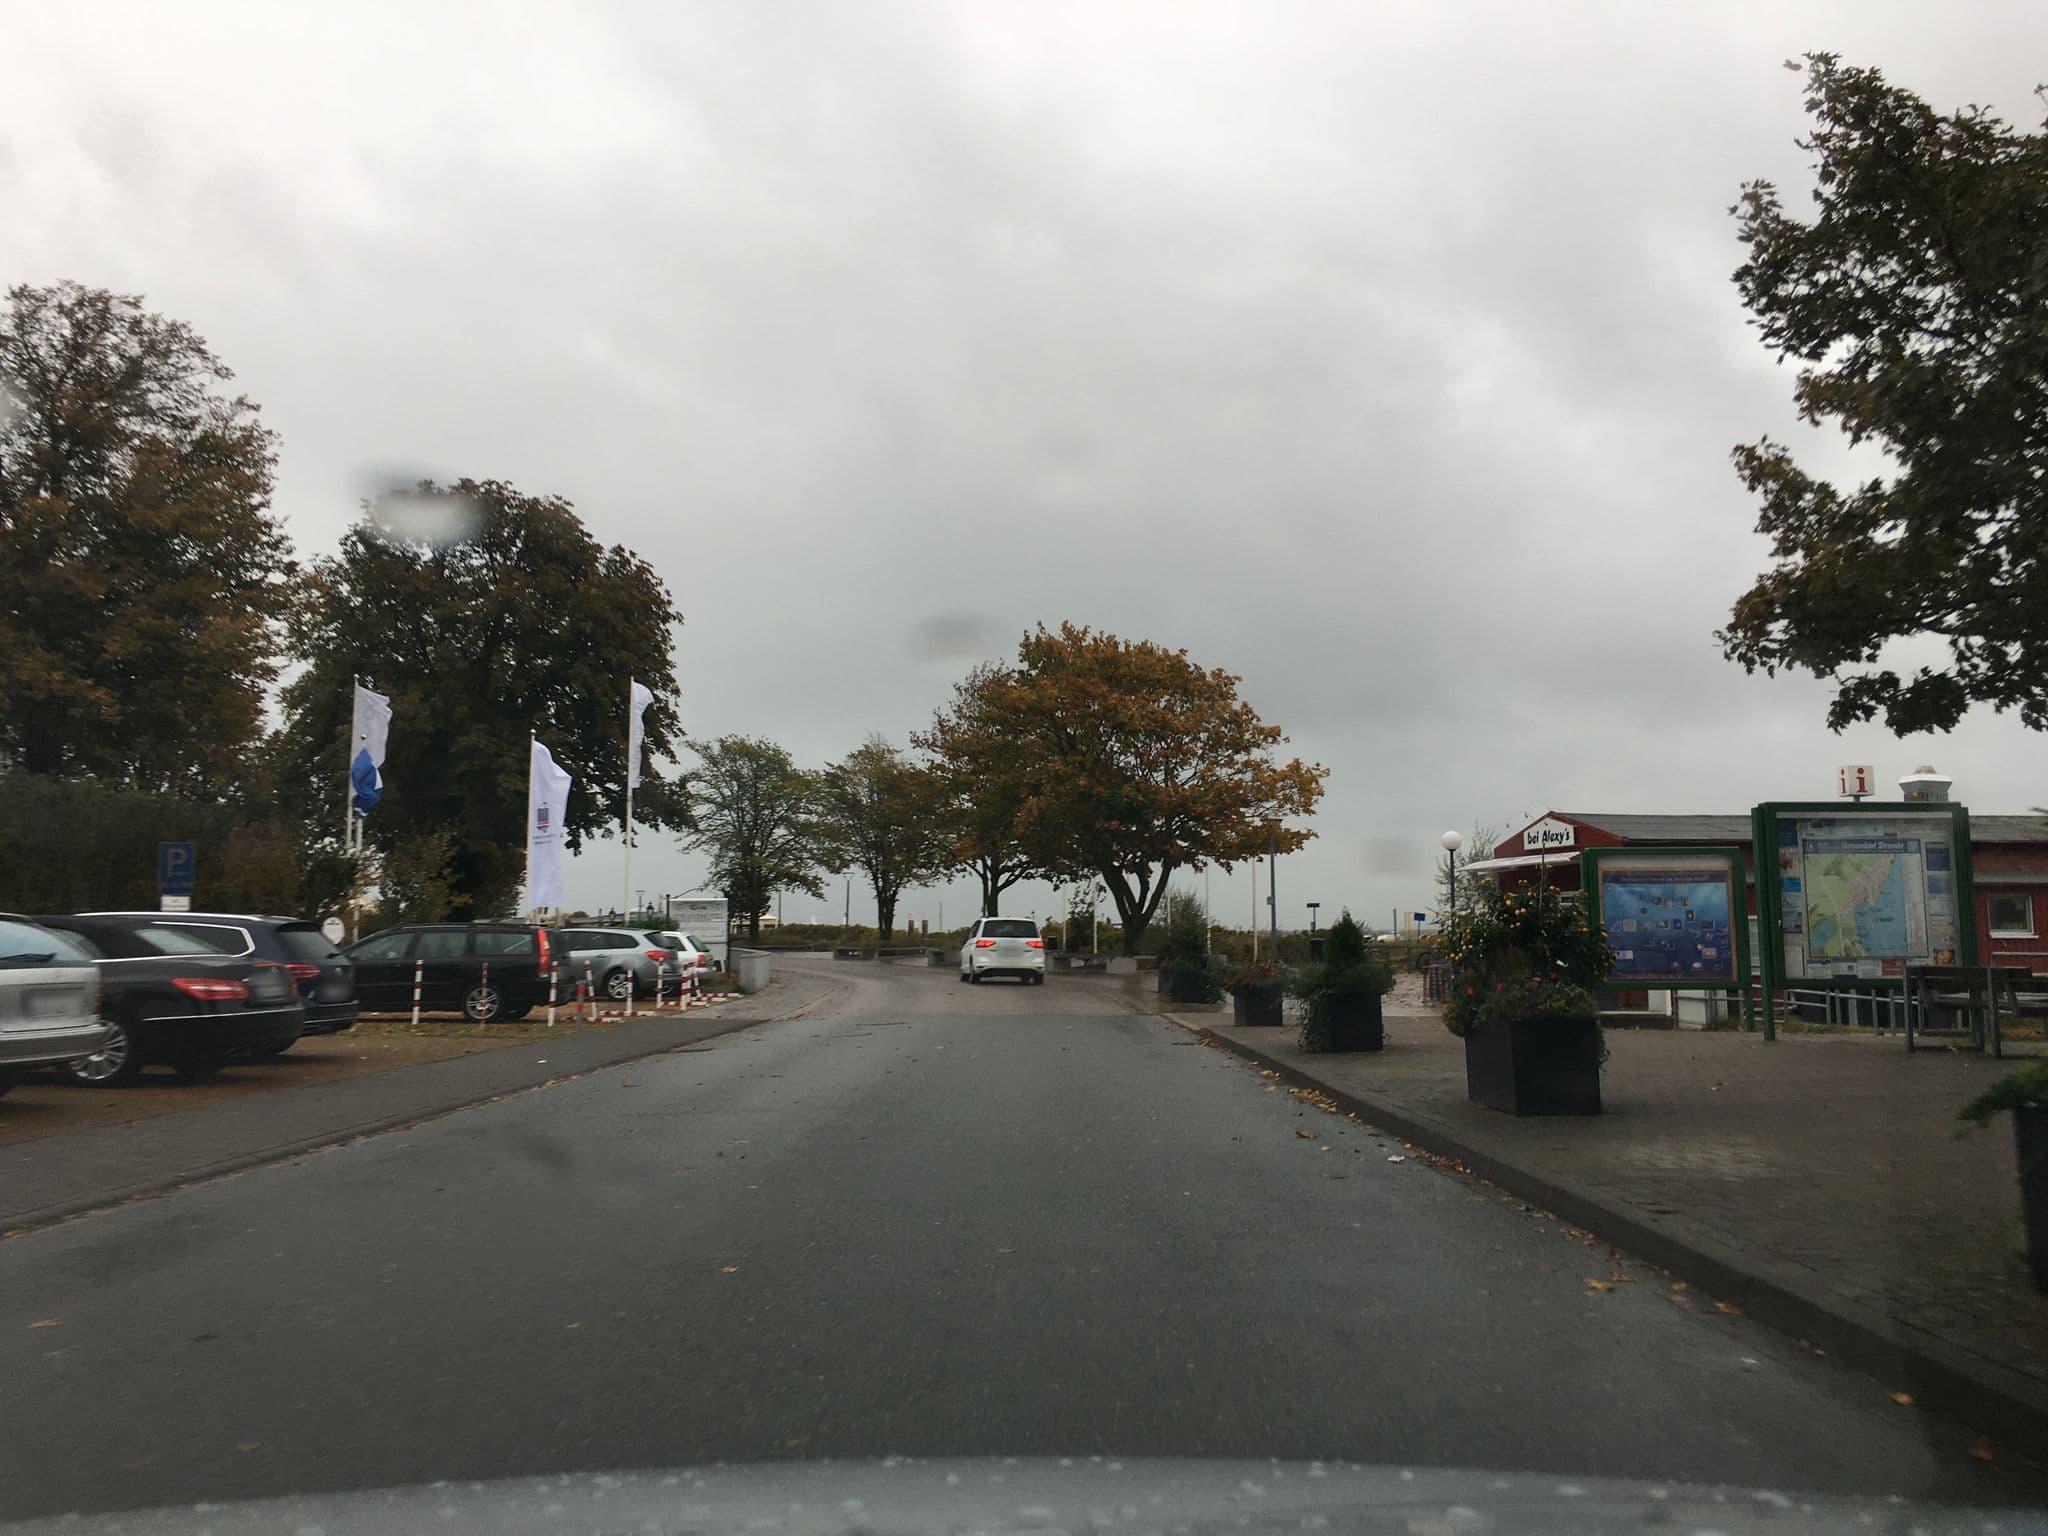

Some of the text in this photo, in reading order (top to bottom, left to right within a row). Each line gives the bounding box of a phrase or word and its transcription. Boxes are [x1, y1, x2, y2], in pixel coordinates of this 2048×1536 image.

[1856, 768, 1868, 793] i
[1527, 828, 1570, 845] bei Alexy's
[167, 848, 187, 877] P
